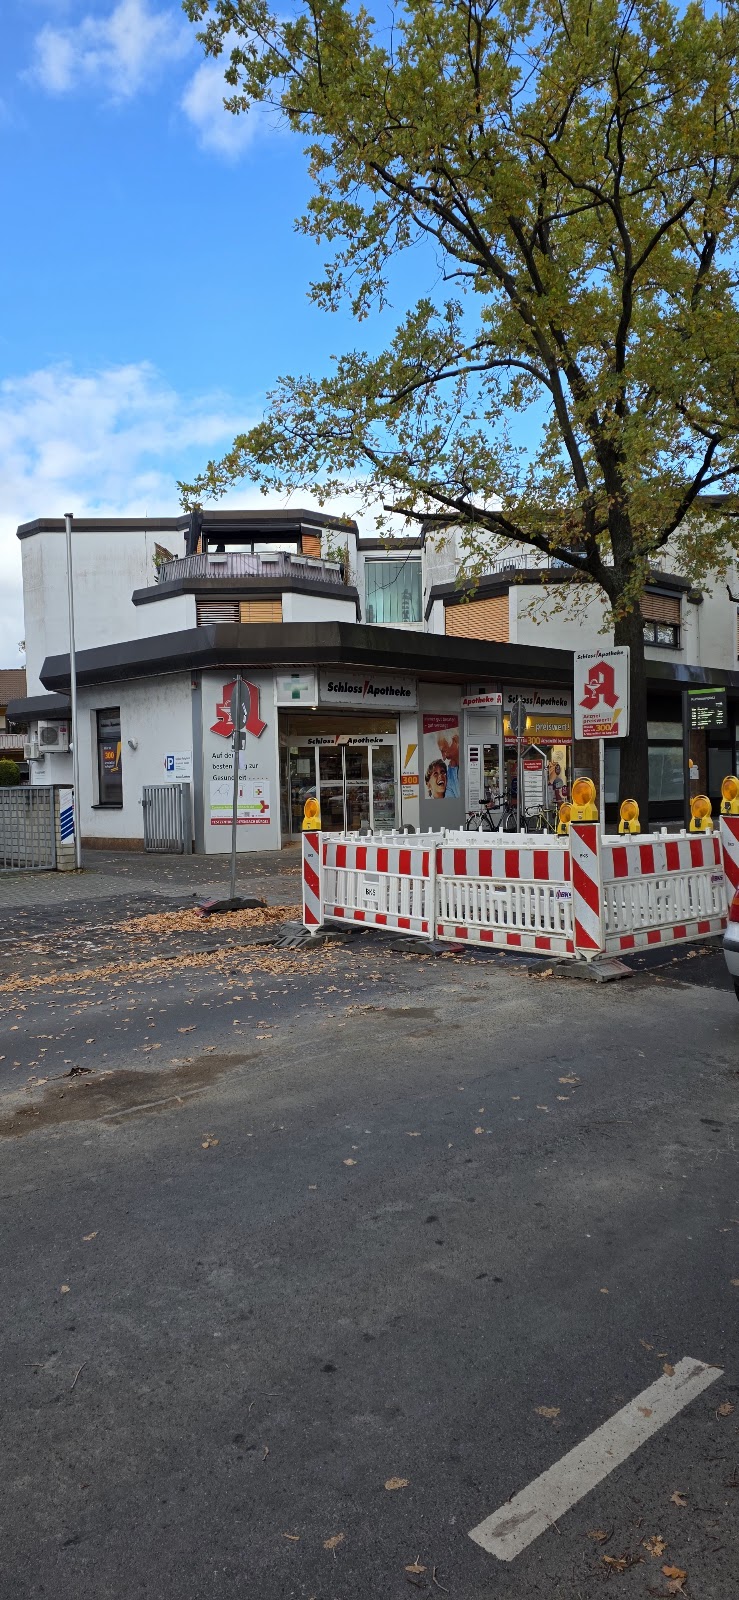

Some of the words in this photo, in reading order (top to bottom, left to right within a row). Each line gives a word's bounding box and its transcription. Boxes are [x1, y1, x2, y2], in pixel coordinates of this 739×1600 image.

[598, 650, 624, 658] Apotheke
[327, 682, 362, 694] Schloss
[366, 684, 412, 697] Apotheke
[462, 696, 494, 706] Apotheke
[536, 696, 568, 706] Apotheke
[536, 722, 570, 732] preiswert!
[528, 736, 540, 744] 300
